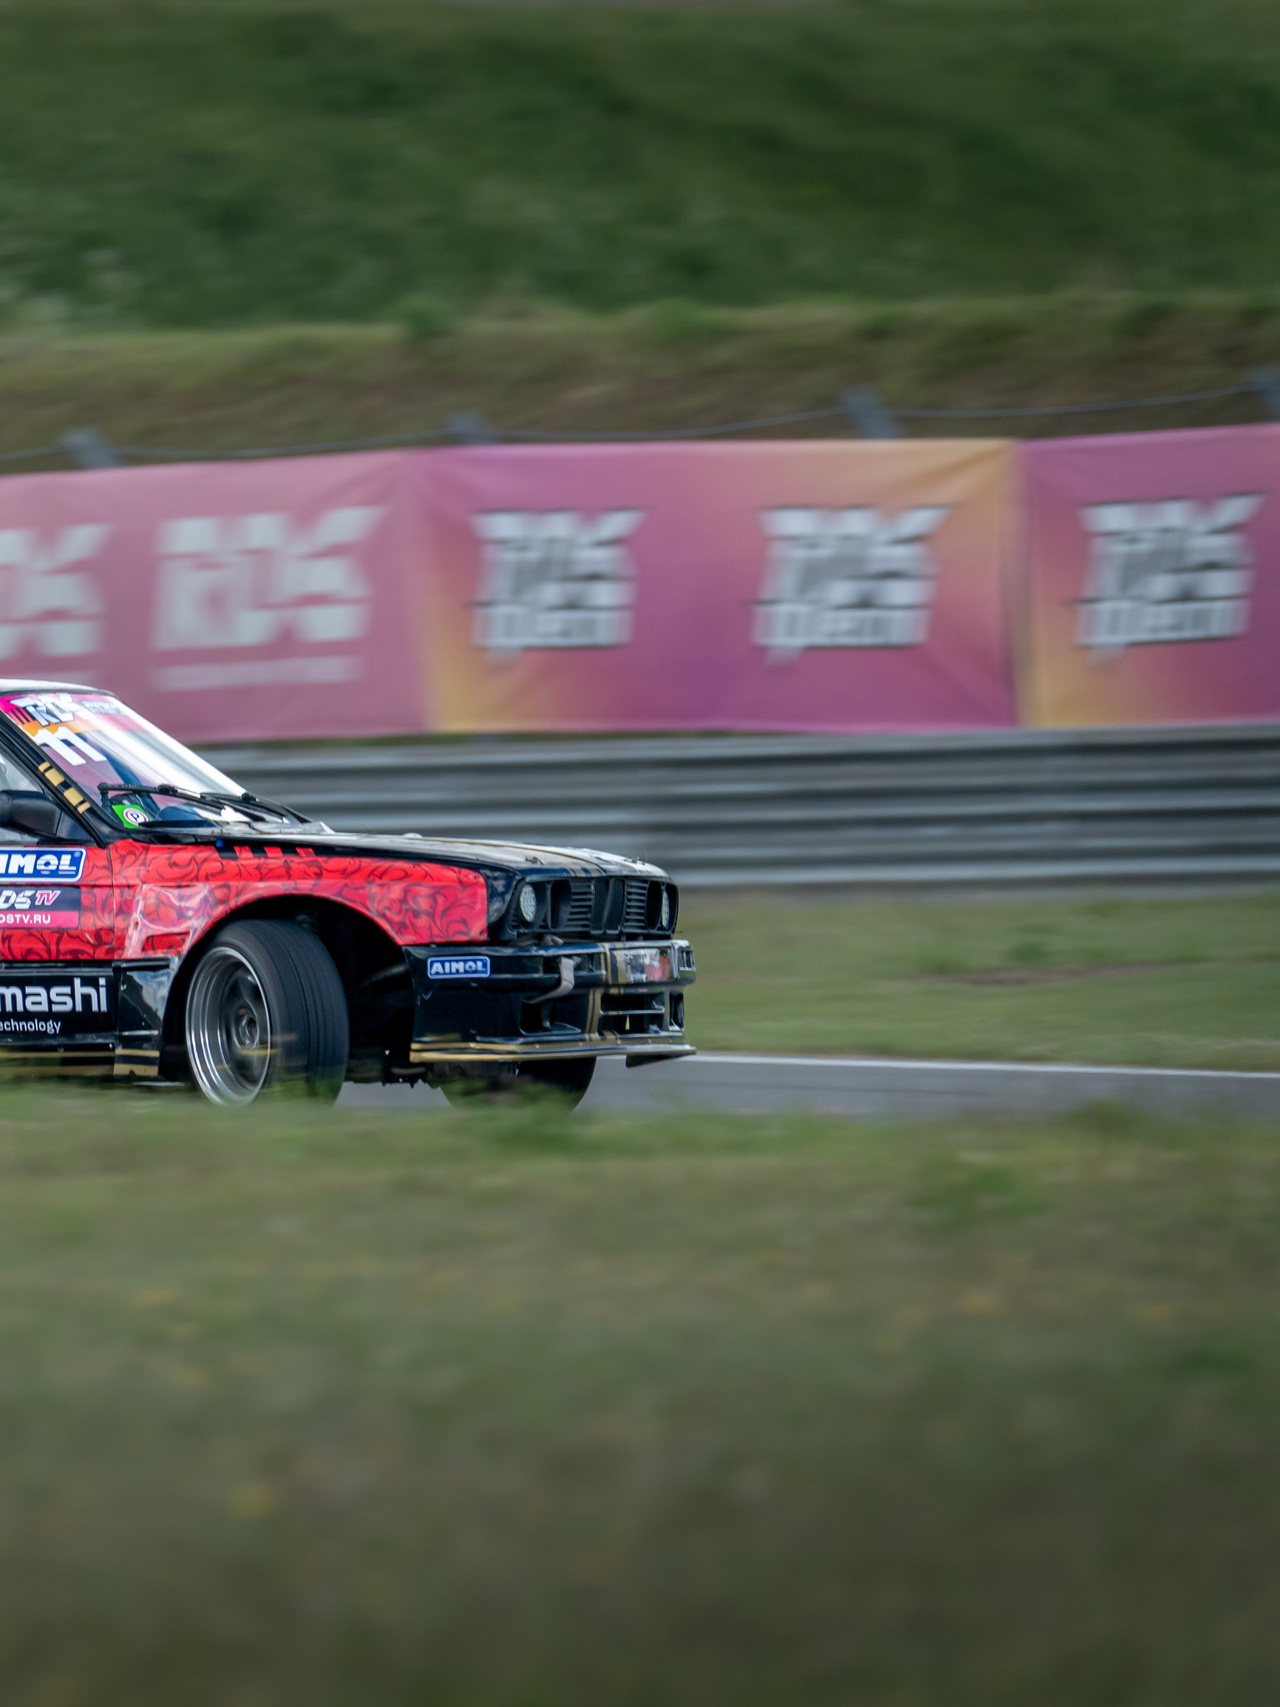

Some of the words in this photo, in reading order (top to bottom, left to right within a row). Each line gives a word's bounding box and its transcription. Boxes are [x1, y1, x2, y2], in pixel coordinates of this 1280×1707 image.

[32, 726, 107, 767] 11
[35, 889, 61, 906] TV
[430, 960, 487, 975] AIMOL
